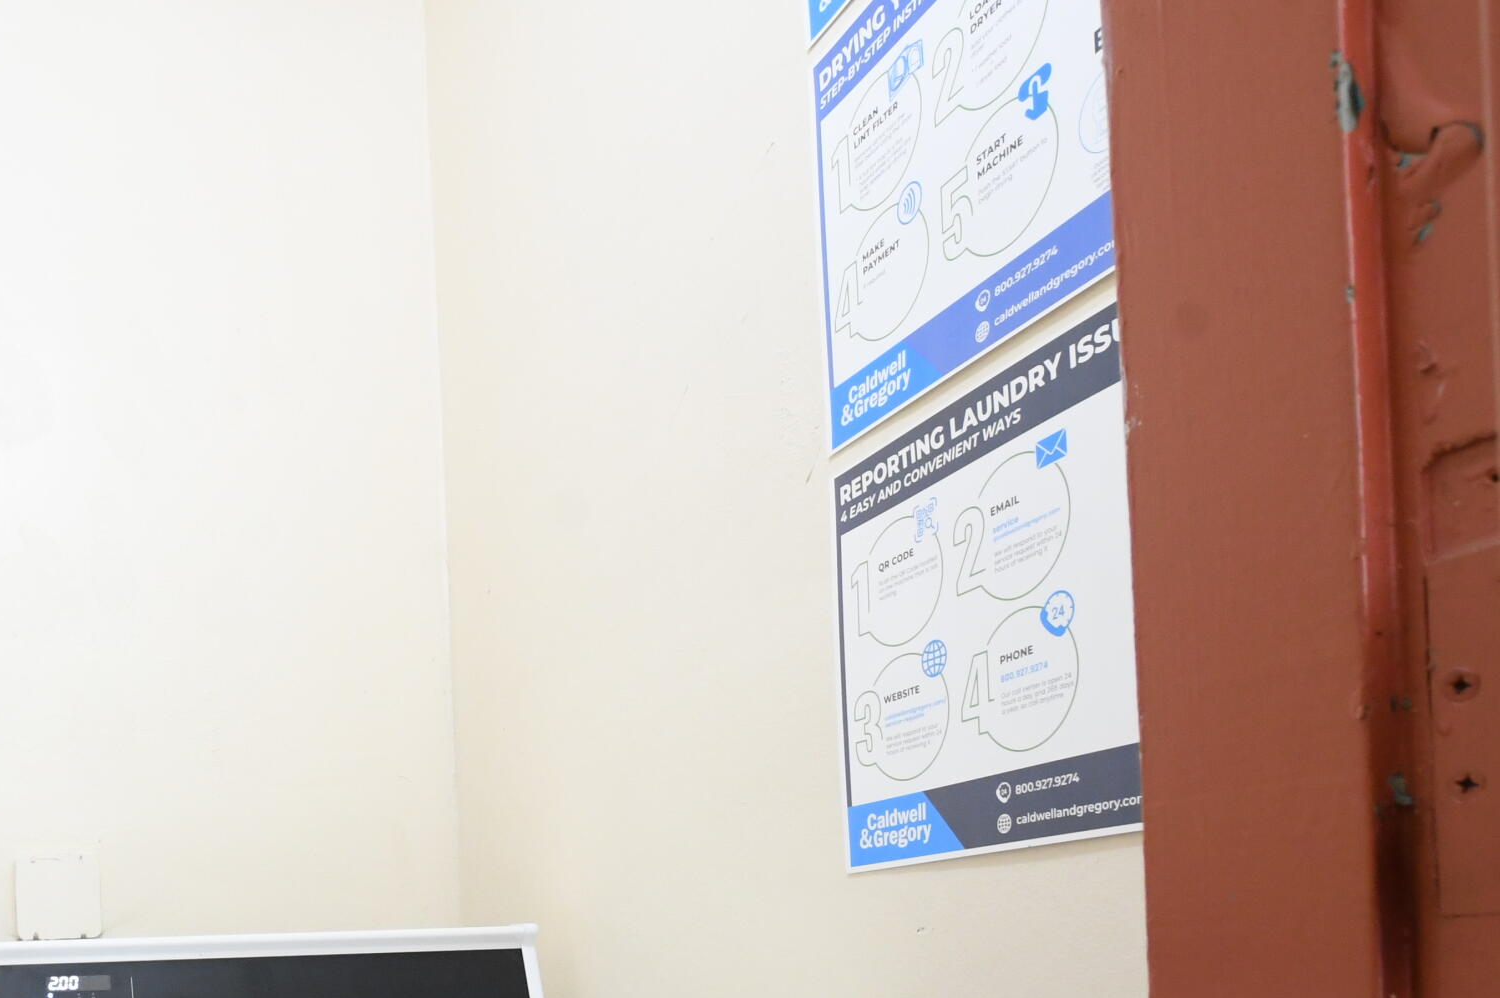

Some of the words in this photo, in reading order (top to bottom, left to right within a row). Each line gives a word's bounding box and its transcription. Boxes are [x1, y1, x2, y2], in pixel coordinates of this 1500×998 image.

[819, 5, 886, 91] DRYING
[820, 27, 891, 110] STEP-BY-STEP
[853, 106, 878, 136] CLEAN
[854, 128, 870, 149] LINT
[873, 101, 898, 131] FILTER
[976, 133, 1006, 165] START
[977, 135, 1024, 180] MACHINE
[862, 238, 885, 262] MAKE
[862, 239, 901, 275] PAYMENT
[994, 245, 1058, 297] 800.927.9274
[994, 239, 1115, 326] caldwellandgregory.co
[848, 349, 906, 404] Caldwell
[839, 426, 945, 505] REPORTING
[950, 351, 1061, 439] LAUNDRY
[840, 509, 848, 523] 4
[850, 490, 876, 518] EASY
[877, 480, 901, 504] AND
[904, 432, 979, 487] CONVENIENT
[983, 408, 1021, 440] WAYS
[990, 496, 1020, 517] EMAIL
[878, 560, 890, 572] QR
[891, 548, 914, 566] CODE
[1051, 605, 1066, 620] 24
[1000, 645, 1034, 664] PHONE
[883, 684, 920, 704] WEBSITE
[1015, 772, 1080, 795] 800.927.9274
[867, 802, 927, 830] Caldwell
